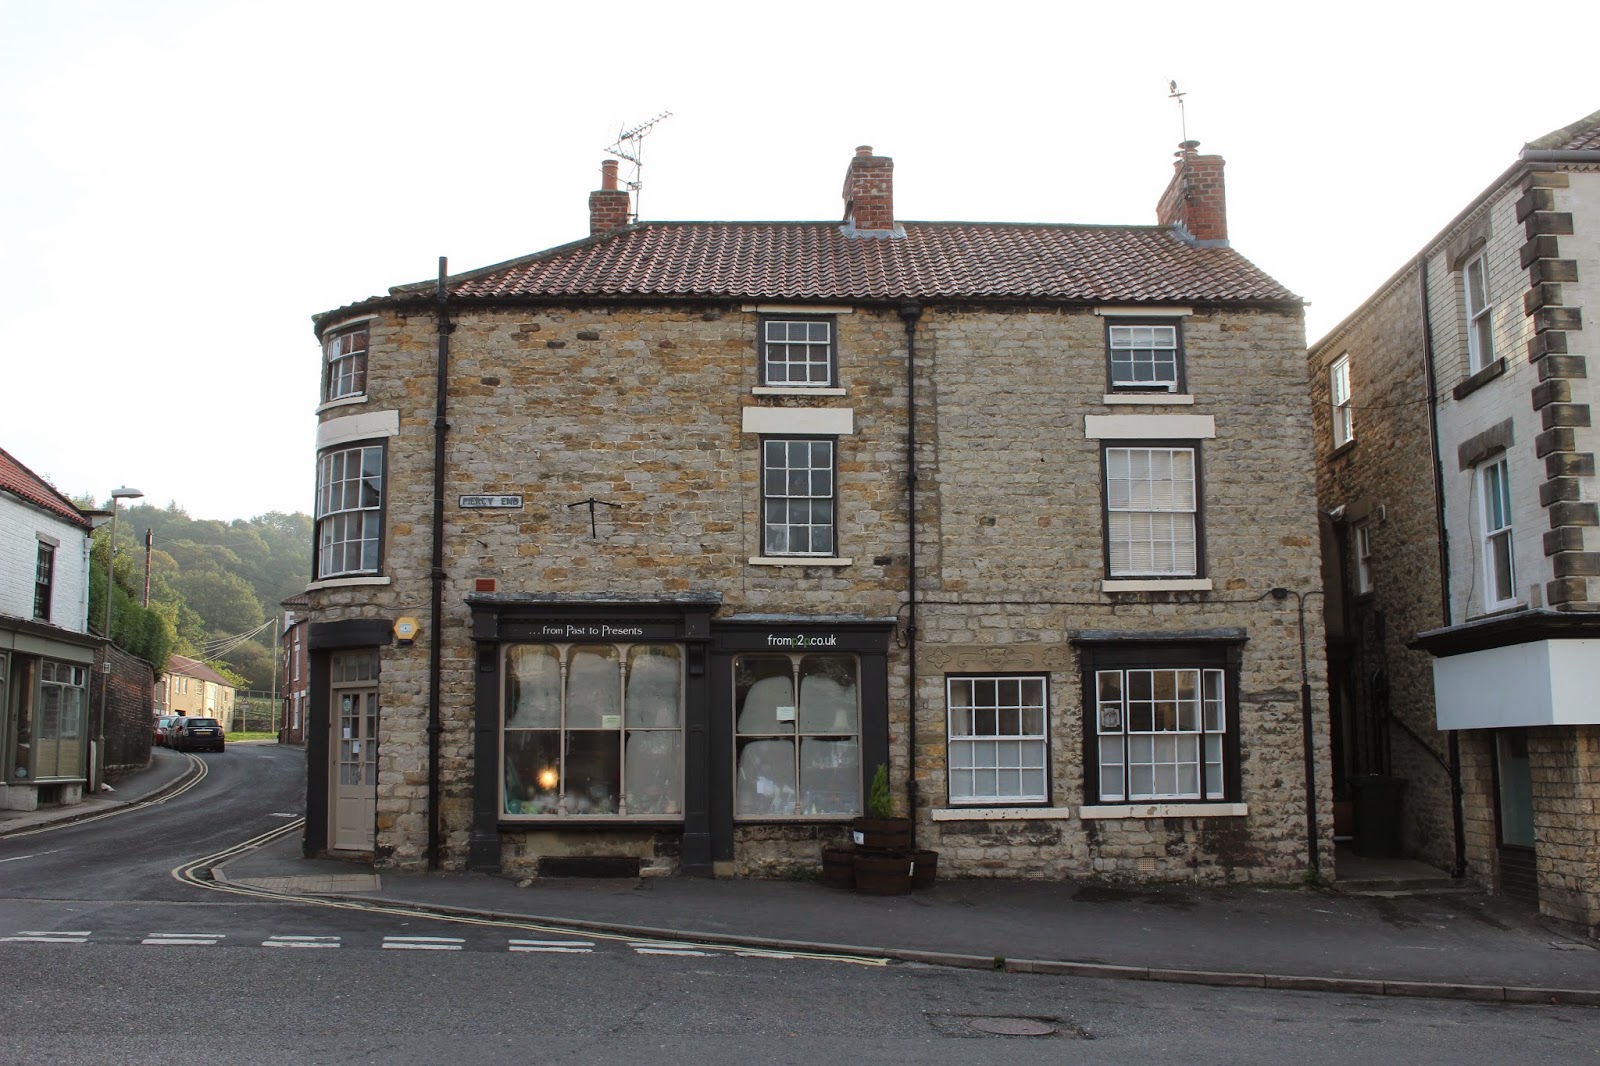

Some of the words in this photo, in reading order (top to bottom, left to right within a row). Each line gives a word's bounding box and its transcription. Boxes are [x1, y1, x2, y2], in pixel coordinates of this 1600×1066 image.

[462, 497, 494, 506] PIERCY
[501, 497, 519, 506] END
[566, 624, 585, 637] Past
[589, 627, 599, 635] to
[602, 624, 643, 637] Presents
[767, 634, 837, 648] fromp2p.co.uk
